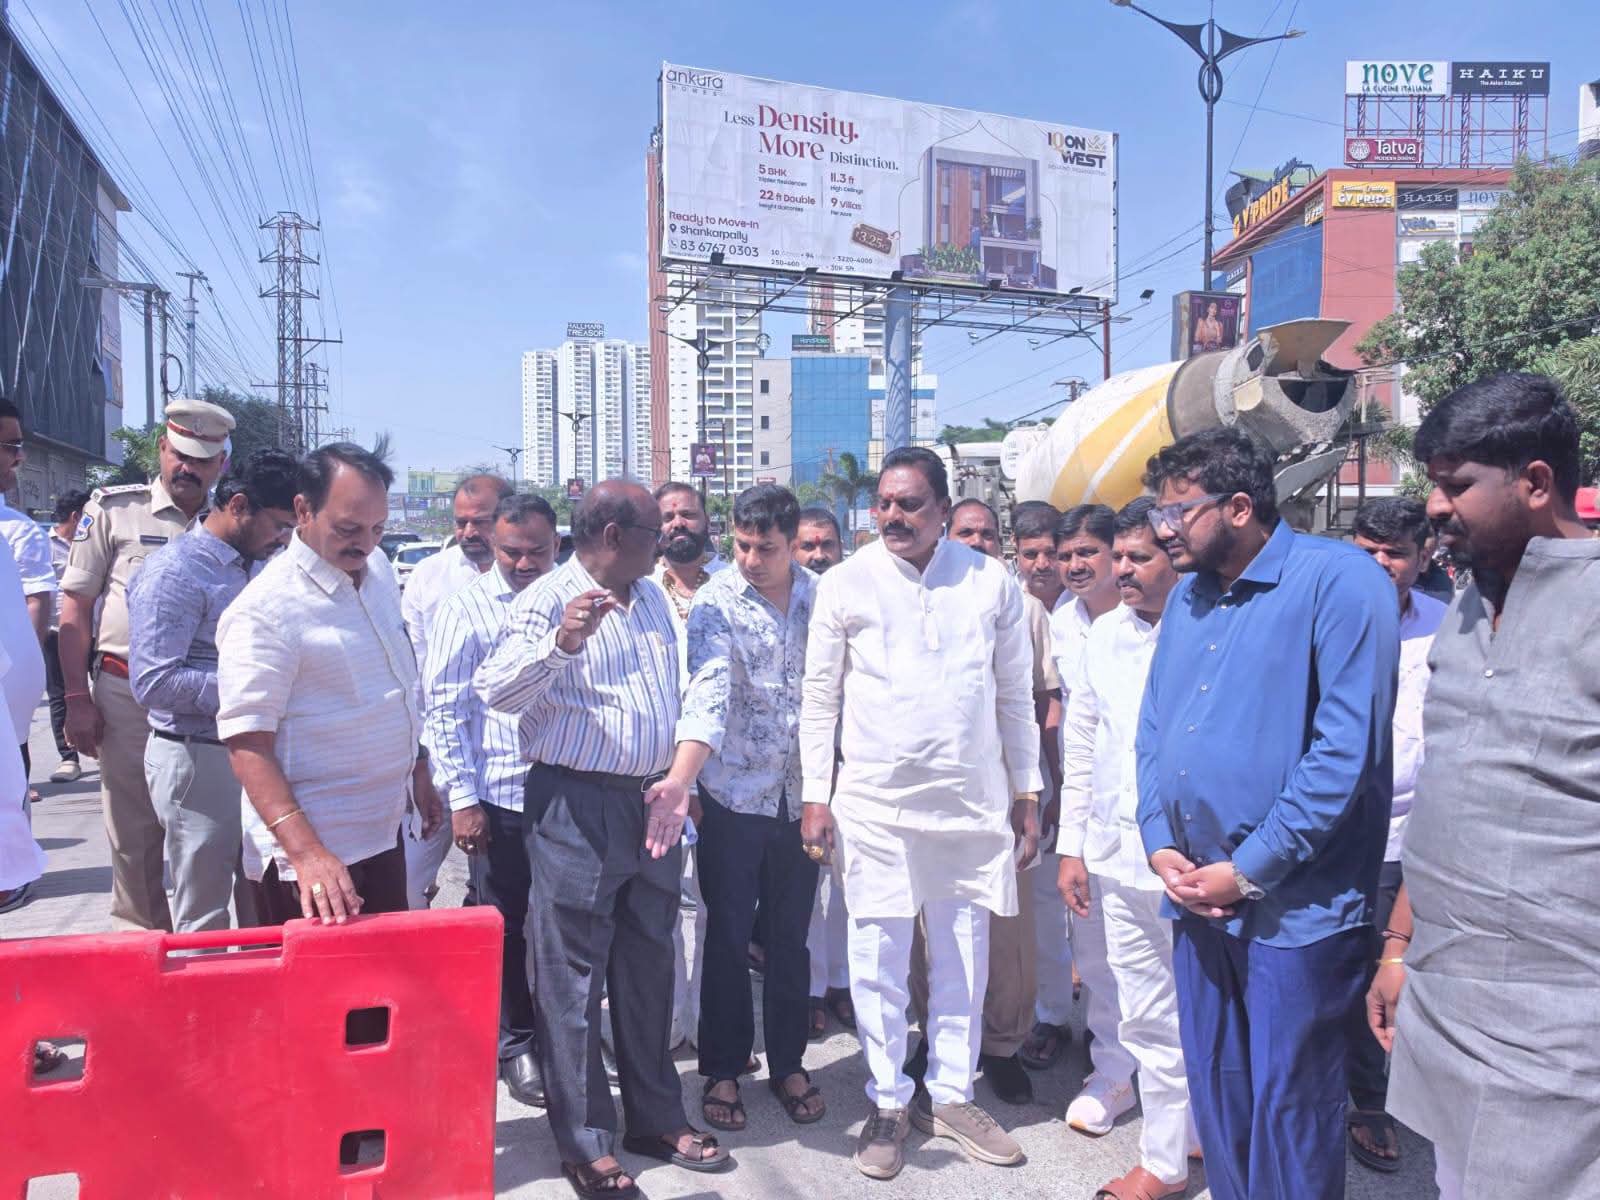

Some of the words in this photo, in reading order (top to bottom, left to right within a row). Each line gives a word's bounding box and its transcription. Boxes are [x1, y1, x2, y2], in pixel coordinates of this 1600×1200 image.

[665, 69, 724, 89] ankura
[1362, 63, 1434, 84] nove
[1459, 69, 1545, 79] HAIKU
[671, 84, 718, 97] HOMES
[1401, 85, 1433, 93] ITALIANA
[724, 110, 756, 127] Less
[758, 104, 860, 145] Density.
[759, 131, 825, 161] More
[830, 151, 900, 171] Distinction.
[1375, 139, 1417, 156] Tatva
[1062, 151, 1107, 169] WEST
[759, 164, 767, 175] 5
[768, 167, 787, 177] BHK
[849, 176, 855, 185] ft
[760, 189, 775, 201] 22
[776, 193, 783, 202] ft
[783, 194, 816, 206] Double
[831, 197, 839, 208] 9
[840, 200, 862, 210] Villas
[1250, 174, 1290, 226] PRIDE
[1356, 194, 1392, 206] PRIDE
[1403, 194, 1453, 203] HAIKU
[669, 211, 704, 226] Ready
[705, 215, 716, 225] to
[718, 217, 759, 229] Move-In
[680, 225, 748, 243] Shankarpally
[680, 239, 696, 251] 83
[698, 242, 726, 254] 6767
[729, 244, 759, 257] 0303
